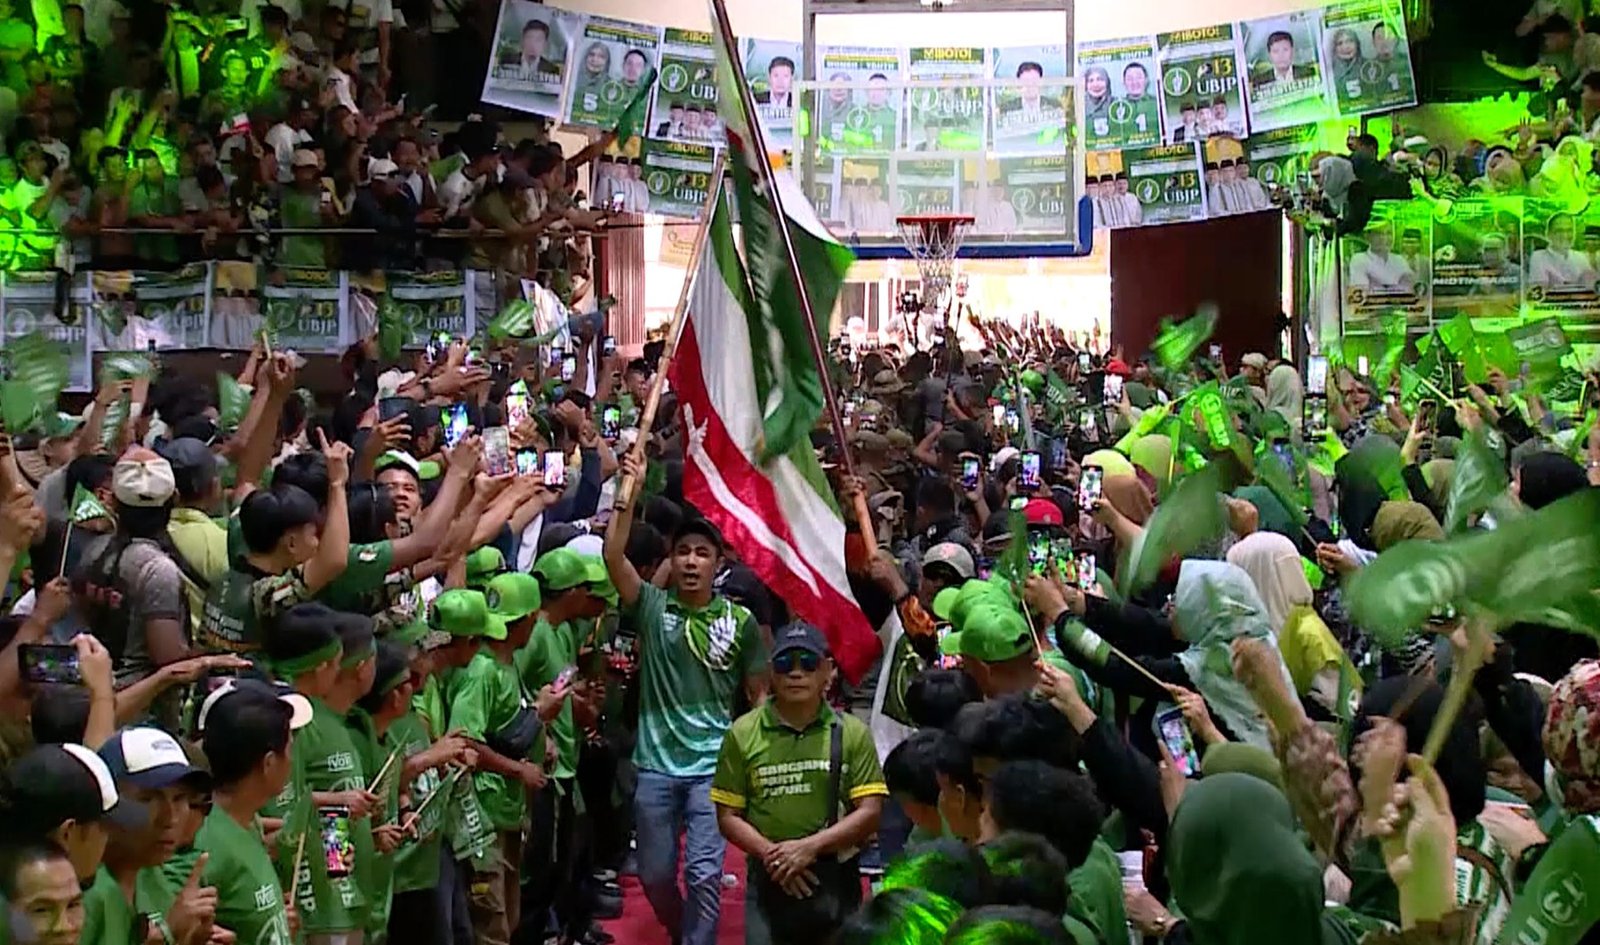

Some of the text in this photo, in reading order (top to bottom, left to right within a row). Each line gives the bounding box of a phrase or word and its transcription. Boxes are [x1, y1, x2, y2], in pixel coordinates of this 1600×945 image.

[1214, 57, 1232, 76] 13
[690, 82, 719, 104] UBJ
[1197, 77, 1237, 95] UBJP
[582, 92, 599, 112] 5
[1136, 113, 1147, 132] 1
[692, 173, 708, 189] 13
[1180, 172, 1195, 188] 13
[674, 187, 708, 204] UBJP
[1164, 188, 1199, 204] UBJP
[1039, 200, 1064, 215] UBJ
[298, 318, 337, 335] UBJP
